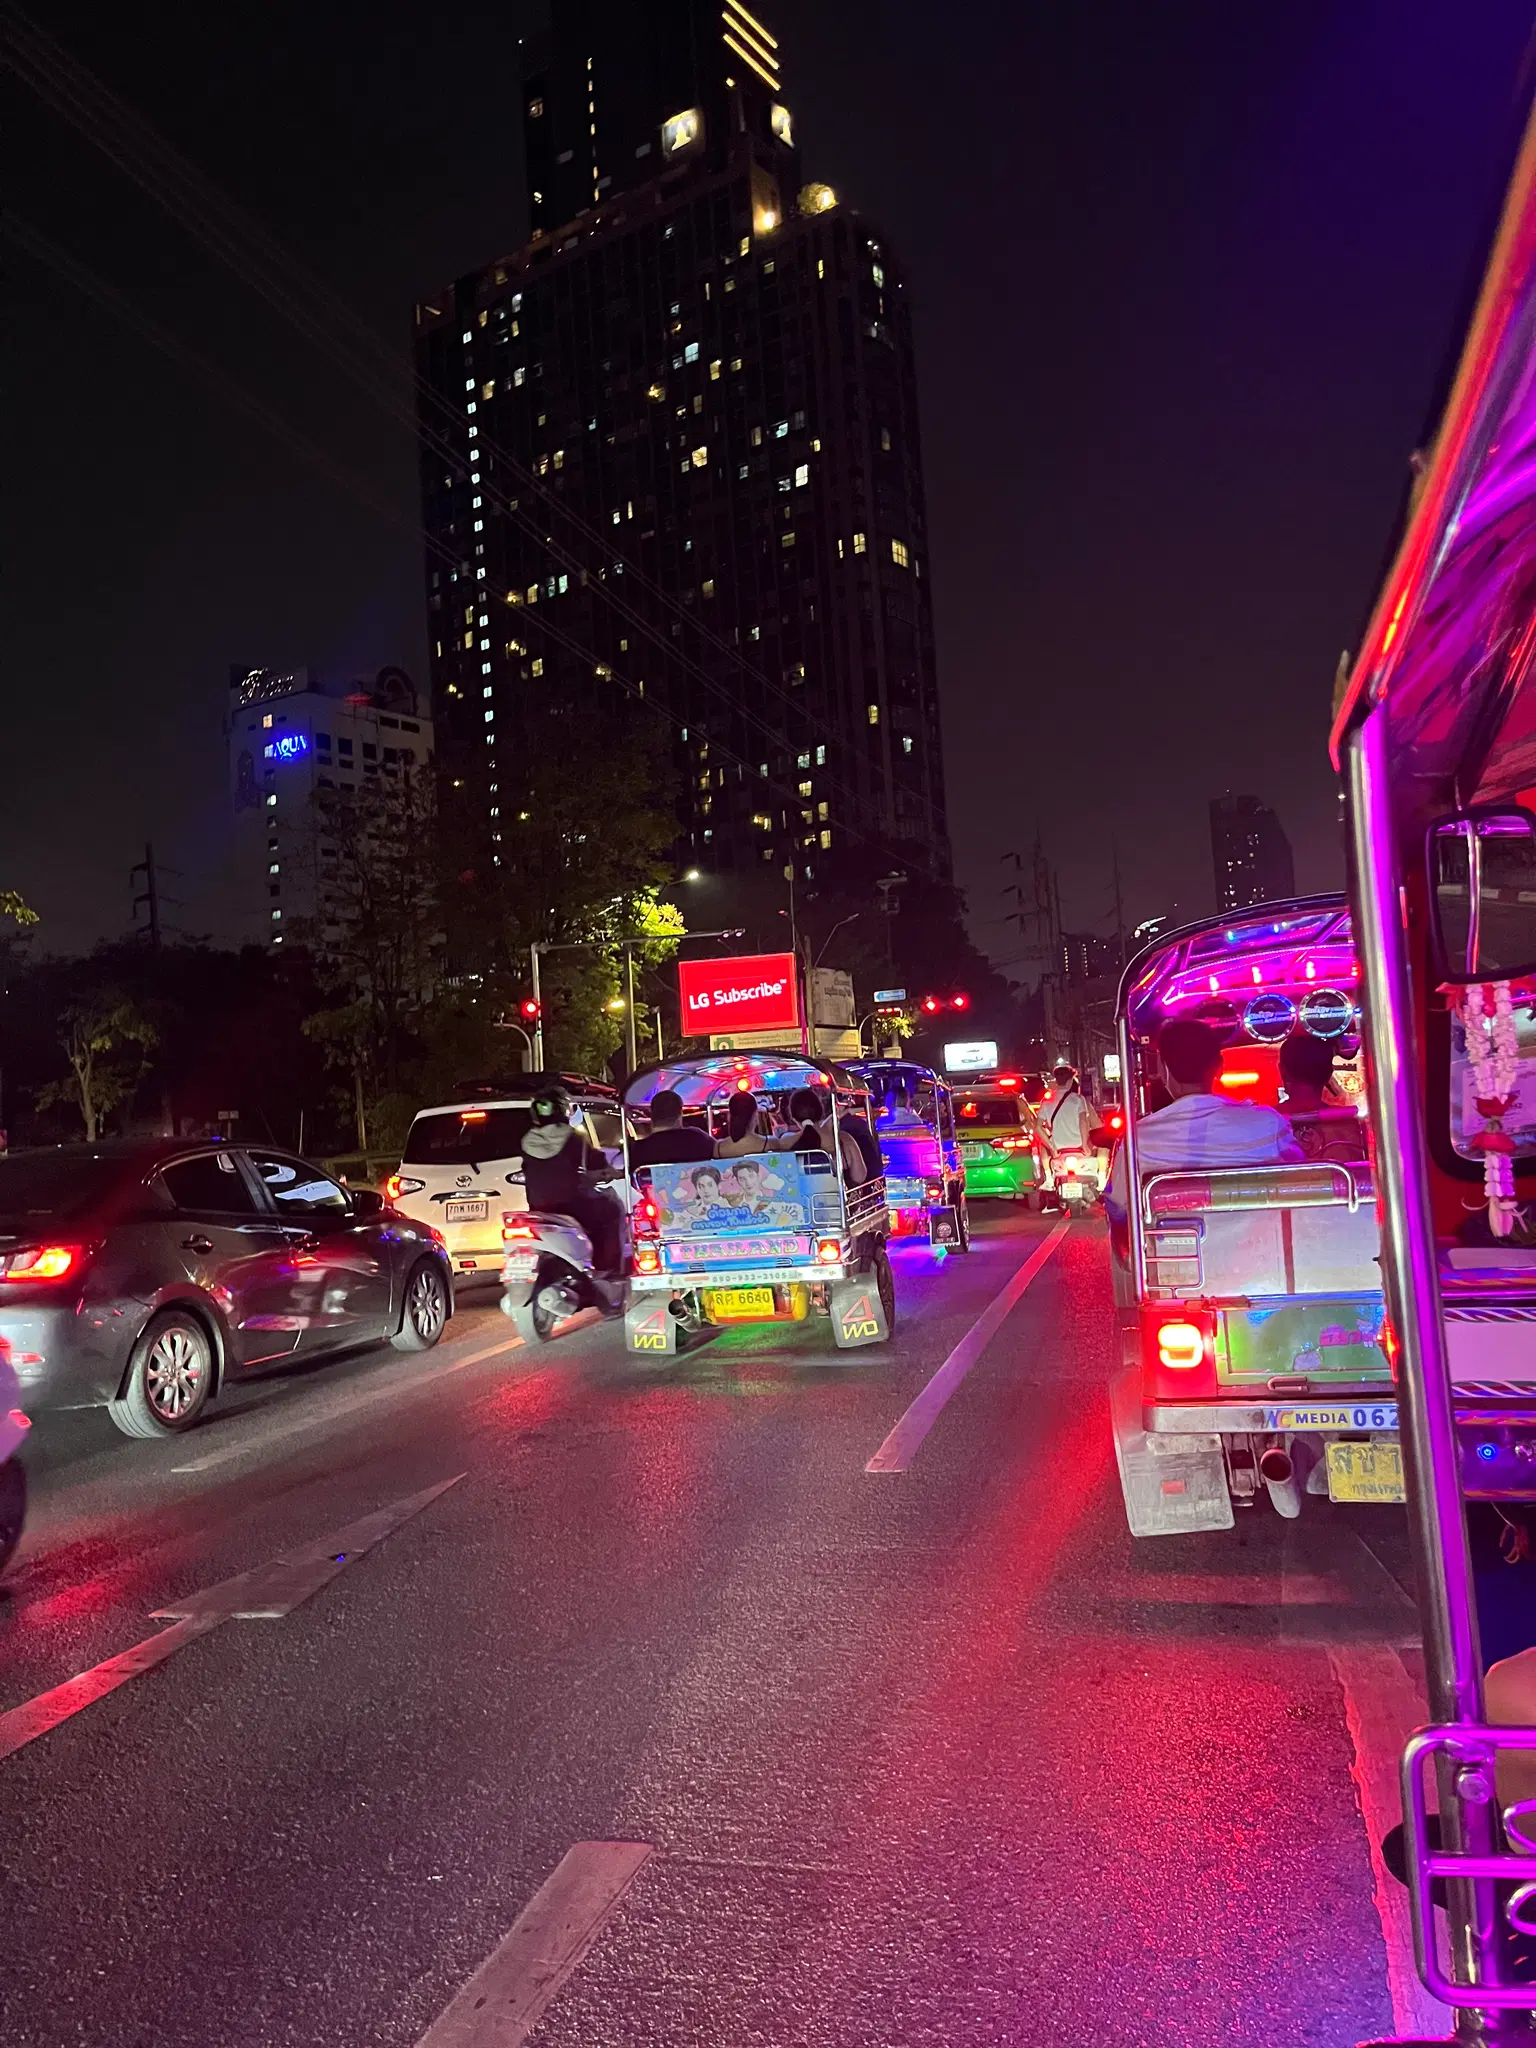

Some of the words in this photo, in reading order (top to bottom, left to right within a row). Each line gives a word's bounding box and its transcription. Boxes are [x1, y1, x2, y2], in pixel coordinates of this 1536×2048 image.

[273, 735, 307, 759] AQUA
[689, 992, 710, 1010] LG
[680, 1238, 799, 1260] THAILAND
[738, 1291, 770, 1305] 6640
[1295, 1413, 1349, 1424] MEDIA
